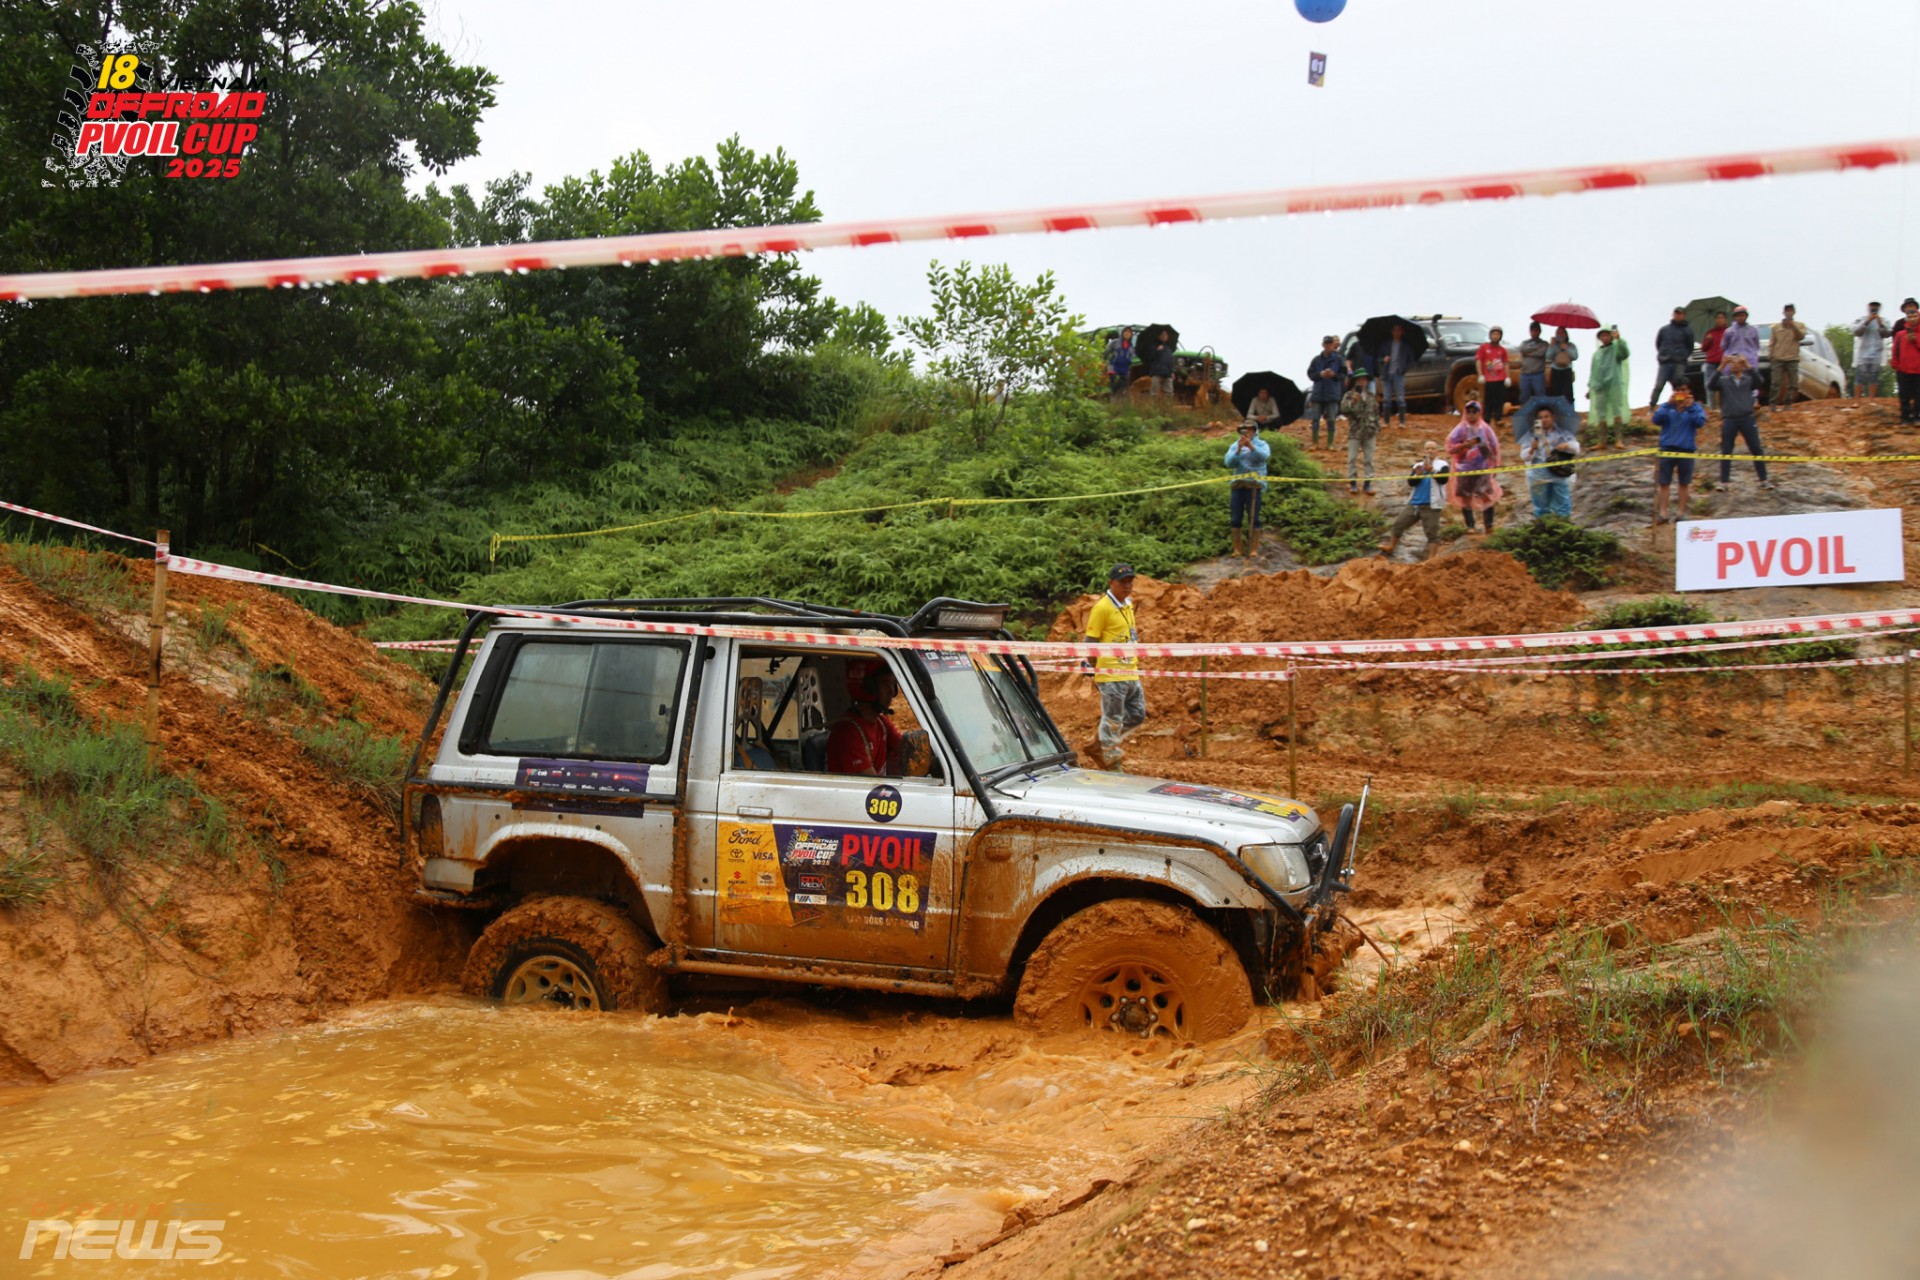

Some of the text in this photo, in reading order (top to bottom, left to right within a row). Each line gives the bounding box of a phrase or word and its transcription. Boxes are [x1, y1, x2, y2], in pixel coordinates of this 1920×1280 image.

[1716, 535, 1857, 580] PVOIL
[869, 798, 898, 817] 308
[728, 828, 763, 846] Ford
[752, 851, 775, 861] VISA
[789, 849, 836, 860] PVOIL CUP
[841, 833, 927, 871] PVOIL
[845, 869, 920, 914] 308
